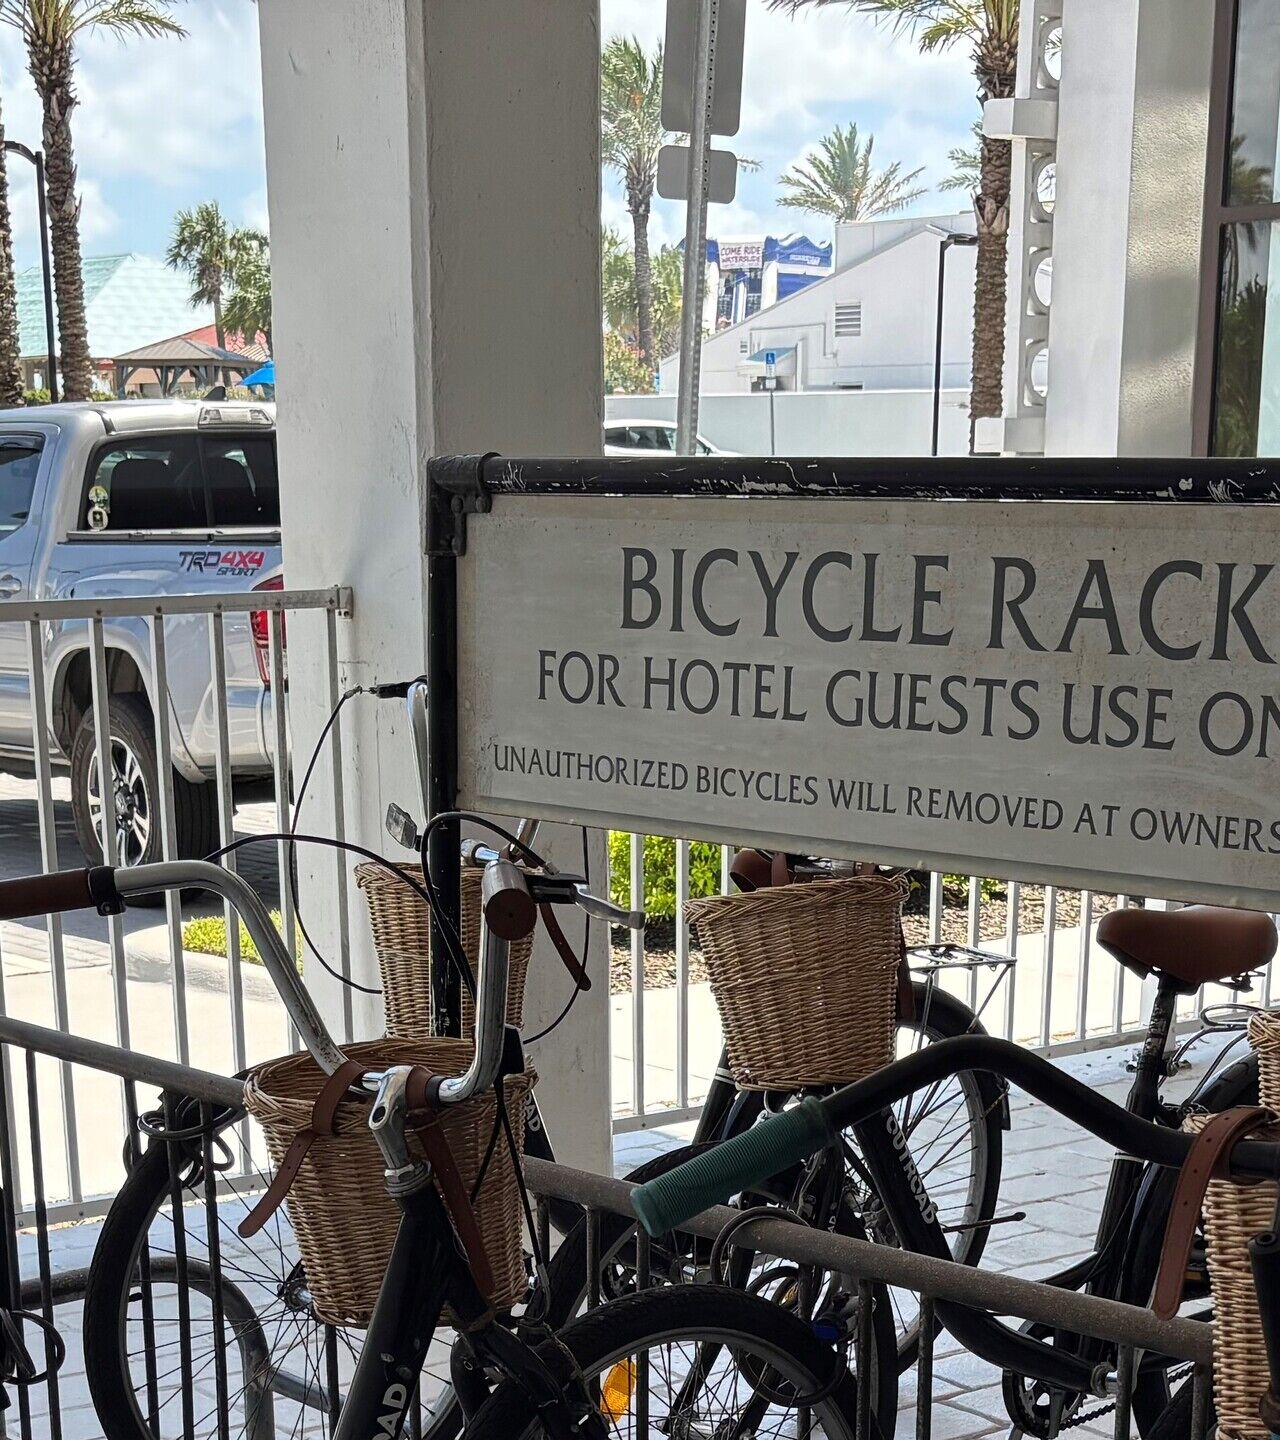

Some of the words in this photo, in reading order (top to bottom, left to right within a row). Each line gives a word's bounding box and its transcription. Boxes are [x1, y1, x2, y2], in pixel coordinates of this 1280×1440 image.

[216, 567, 260, 577] SPORT
[620, 547, 954, 646] BICYCLE
[986, 556, 1278, 664] RACK
[538, 649, 626, 708] FOR
[643, 656, 808, 722] HOTEL
[825, 669, 1040, 740] GUESTS
[1061, 682, 1176, 751] USE
[494, 744, 688, 792] UNAUTHORIZED
[696, 765, 818, 806] BICYCLES
[827, 778, 897, 814] WILL
[906, 786, 1064, 830] REMOVED
[1073, 803, 1121, 837] AT
[886, 1115, 935, 1225] OUTROAD
